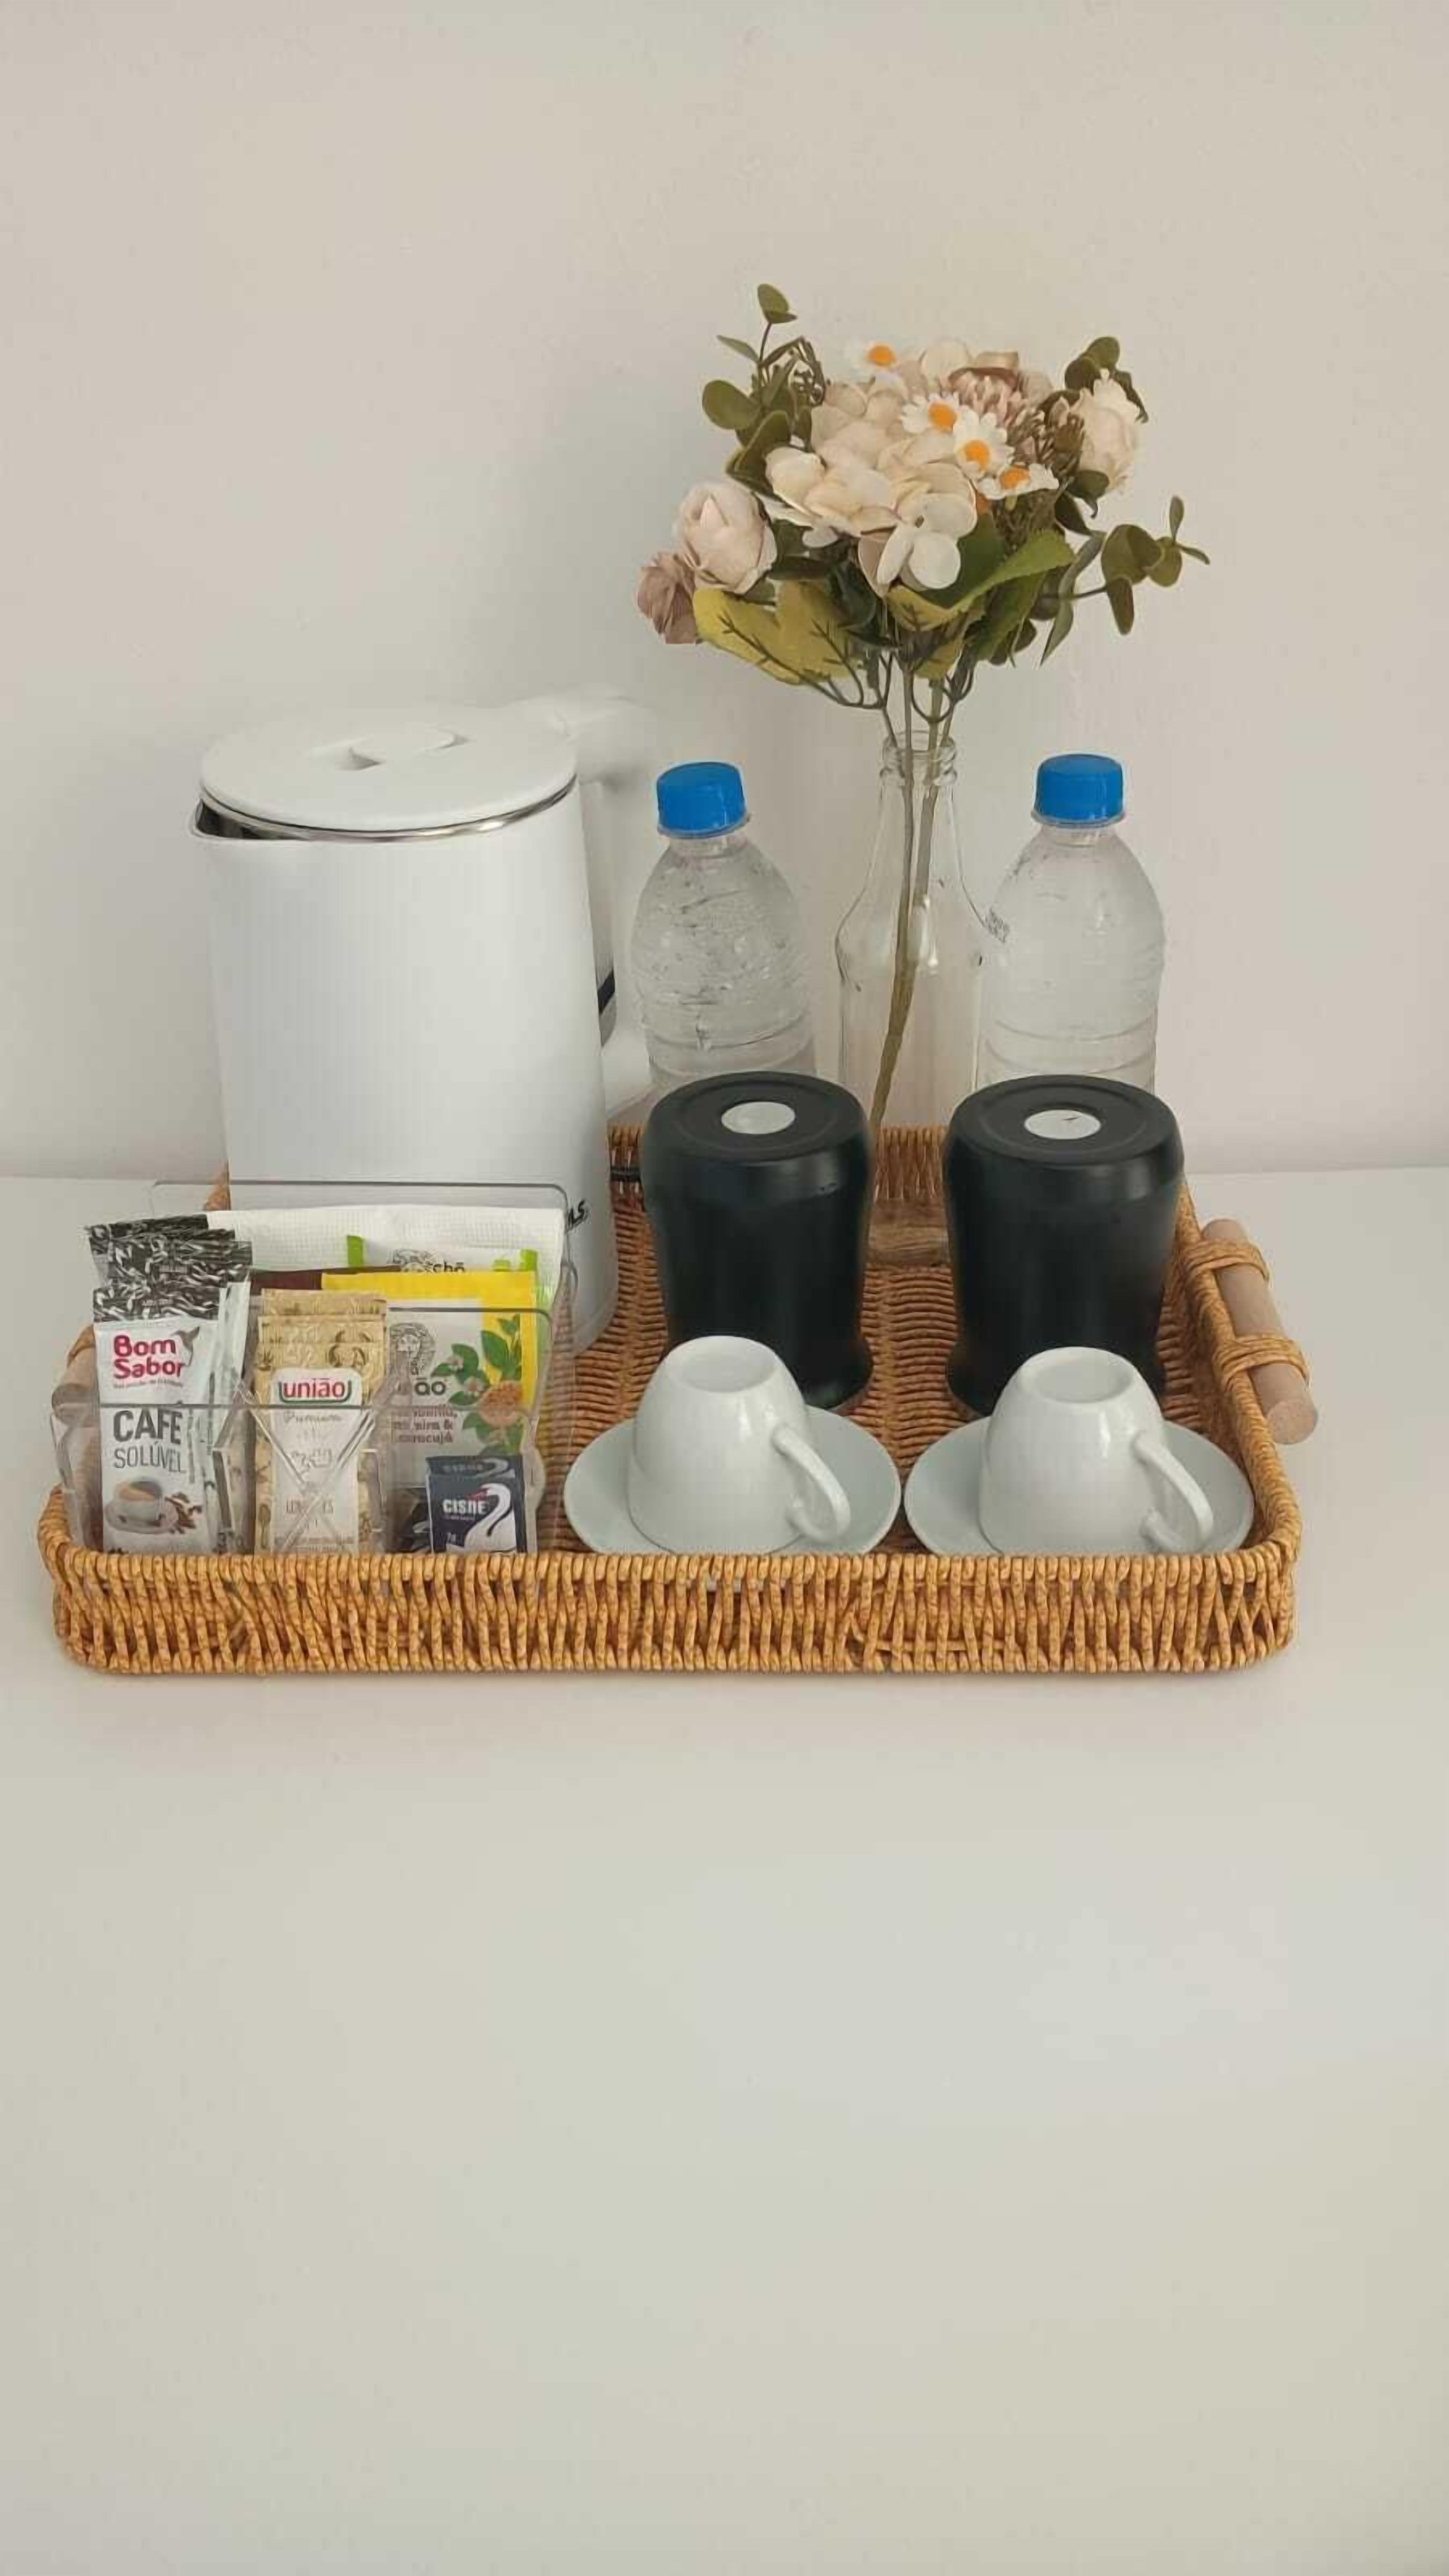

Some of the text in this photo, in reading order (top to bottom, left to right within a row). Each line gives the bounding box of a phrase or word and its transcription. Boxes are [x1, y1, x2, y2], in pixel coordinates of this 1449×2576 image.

[114, 1335, 176, 1357] Bom
[114, 1357, 185, 1379] Sabor
[283, 1378, 345, 1398] união
[414, 1377, 446, 1396] ão
[114, 1441, 186, 1474] SOLÚVEL
[443, 1499, 488, 1515] CISNE
